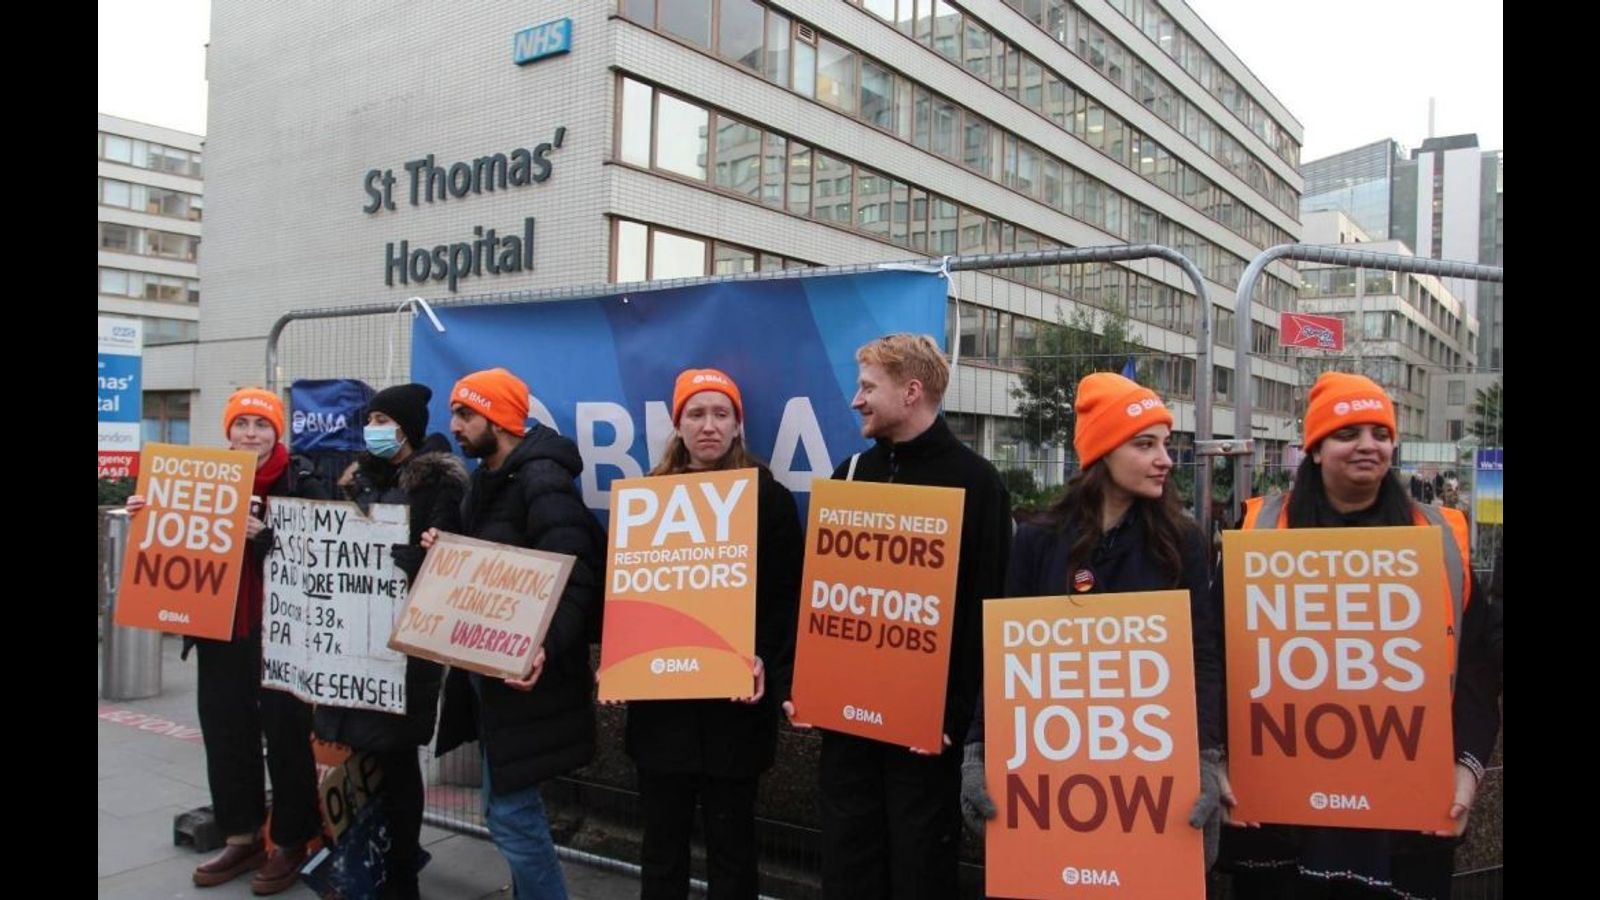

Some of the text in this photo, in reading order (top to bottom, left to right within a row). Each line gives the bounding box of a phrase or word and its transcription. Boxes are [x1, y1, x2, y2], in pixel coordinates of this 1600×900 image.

[515, 21, 566, 60] NHS
[364, 126, 567, 215] St Thomas'
[385, 217, 534, 292] Hospital
[469, 391, 493, 410] BMA
[307, 412, 348, 433] BMA
[152, 456, 242, 482] DOCTORS
[146, 477, 239, 515] NEED
[615, 479, 749, 548] PAY
[139, 511, 234, 553] JOBS
[314, 508, 347, 535] MY
[819, 507, 948, 535] PATIENTS NEED
[429, 549, 472, 579] NOT
[615, 544, 748, 565] RESTORATION FOR
[816, 527, 945, 570] DOCTORS
[1245, 549, 1419, 578] DOCTORS
[133, 552, 228, 596] NOW
[338, 573, 373, 595] THAN
[377, 579, 407, 599] ME?
[472, 556, 554, 600] MOANING
[612, 562, 748, 593] DOCTORS
[167, 612, 190, 624] BMA
[446, 586, 521, 621] MINNIES
[811, 579, 941, 626] DOCTORS
[1246, 582, 1422, 631] NEED
[270, 621, 291, 645] PA
[401, 607, 531, 657] JUST UNDERPAID
[809, 612, 937, 654] NEED JOBS
[1003, 614, 1168, 648] DOCTORS
[666, 658, 699, 673] BMA
[1004, 650, 1170, 699] NEED
[1250, 636, 1425, 699] JOBS
[329, 673, 403, 708] SENSE!!
[854, 709, 883, 726] BMA
[1250, 702, 1426, 762] NOW
[1006, 703, 1173, 770] JOBS
[1006, 773, 1174, 834] NOW
[1330, 794, 1370, 811] BMA
[1080, 869, 1120, 886] BMA
